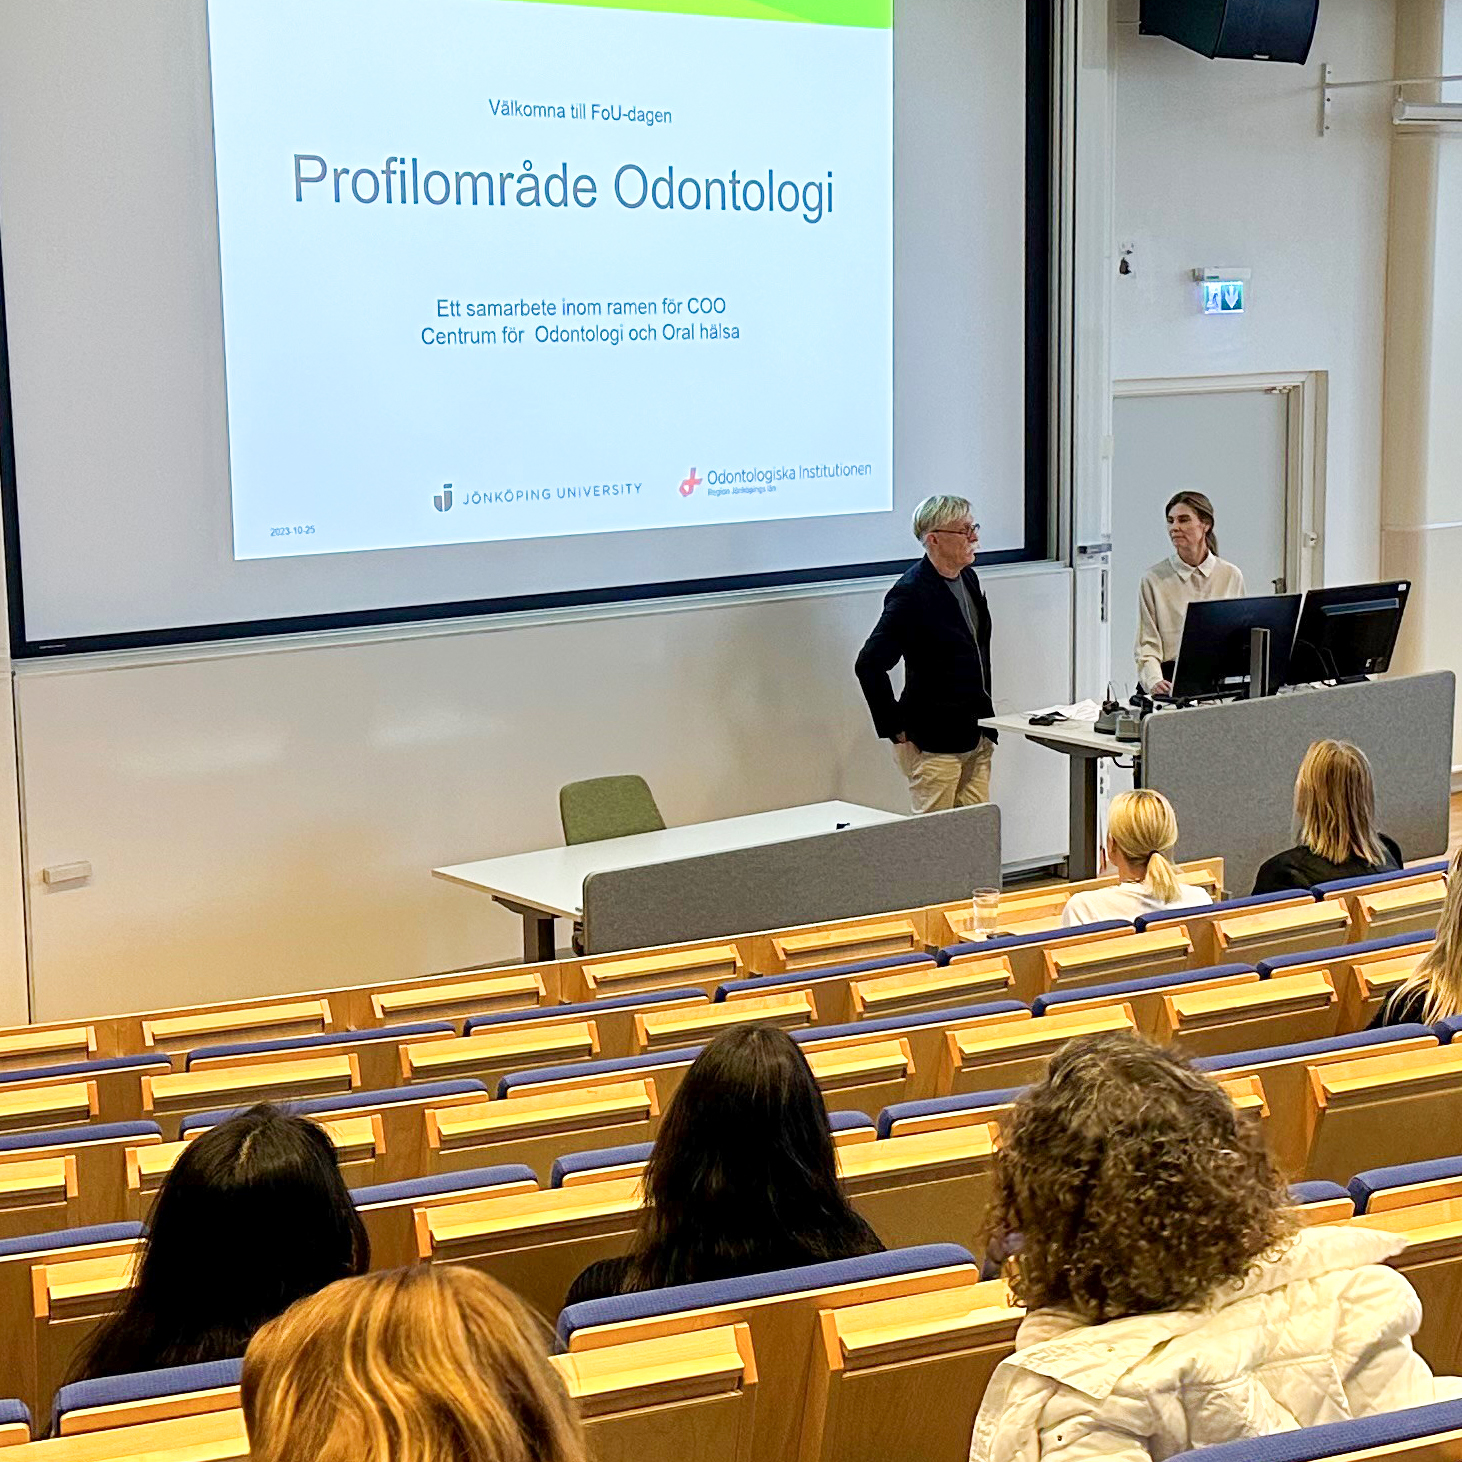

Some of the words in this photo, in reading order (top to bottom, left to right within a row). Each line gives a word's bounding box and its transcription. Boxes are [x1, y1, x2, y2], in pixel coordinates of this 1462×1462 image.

[488, 98, 566, 119] Välkomna
[570, 102, 587, 121] till
[591, 103, 673, 127] FoU-dagen
[293, 153, 598, 209] Profilområde
[613, 162, 834, 225] Odontologi
[436, 298, 461, 318] Ett
[466, 297, 557, 317] samarbete
[561, 297, 602, 317] inom
[606, 301, 657, 316] ramen
[661, 297, 683, 315] för
[687, 296, 727, 315] COO
[421, 326, 497, 346] Centrum
[501, 325, 526, 345] för
[534, 323, 624, 347] Odontologi
[628, 323, 657, 342] och
[661, 322, 695, 341] Oral
[699, 321, 740, 340] hälsa
[707, 465, 796, 485] Odontologiska
[799, 462, 872, 480] Institutionen
[462, 488, 551, 506] JÖNKÖPING
[556, 482, 643, 500] UNIVERSITY
[270, 525, 316, 537] 2023-10-25
